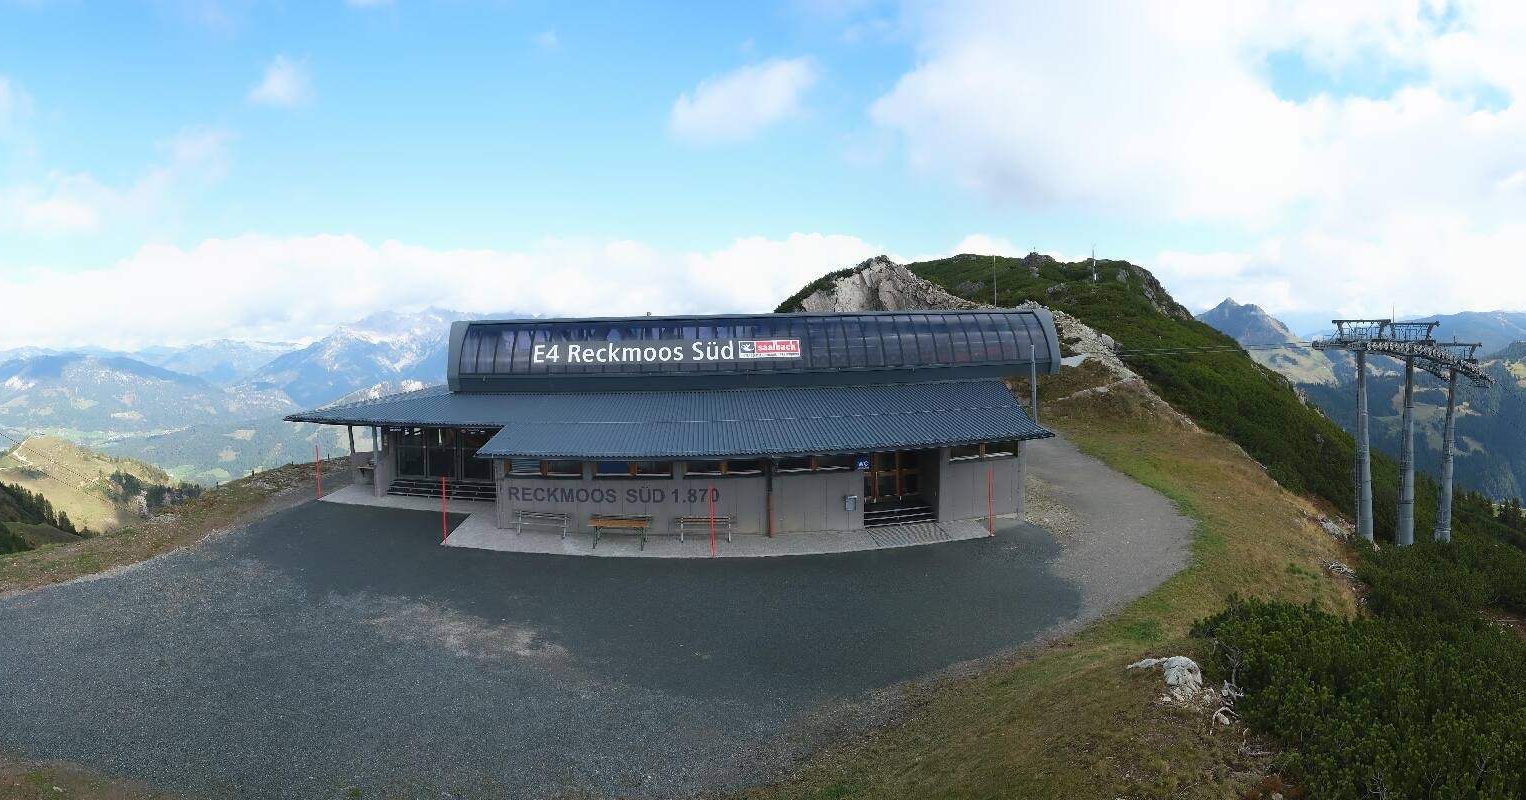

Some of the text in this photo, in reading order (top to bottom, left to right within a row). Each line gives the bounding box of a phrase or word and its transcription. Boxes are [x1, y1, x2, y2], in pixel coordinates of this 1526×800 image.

[533, 340, 735, 364] E4 Reckmoos Süd
[508, 485, 720, 503] RECKMOOS SÜD 1.870
